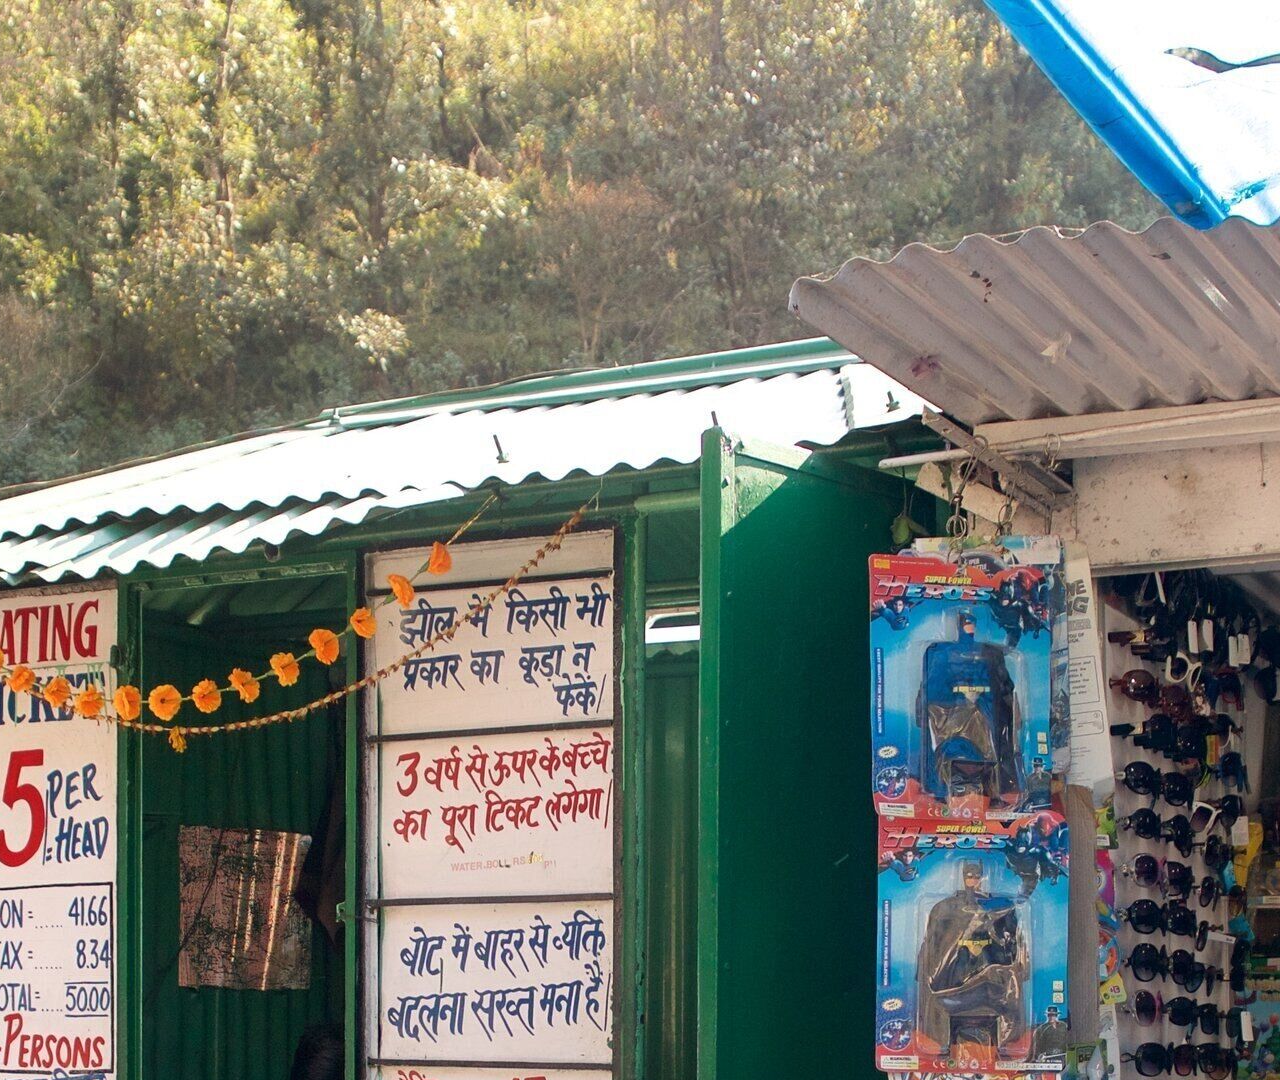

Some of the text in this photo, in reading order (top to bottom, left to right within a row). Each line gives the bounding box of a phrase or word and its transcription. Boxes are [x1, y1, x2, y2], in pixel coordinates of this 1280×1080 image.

[874, 574, 999, 600] HEROES
[924, 575, 946, 584] SUPER
[398, 598, 457, 649] झील
[505, 586, 570, 637] किसी
[575, 582, 611, 628] भी
[402, 653, 466, 691] प्रकार
[470, 649, 505, 685] का
[572, 642, 596, 674] न
[46, 763, 104, 818] PER
[396, 751, 421, 797] 3
[424, 744, 462, 793] वर्ष
[466, 744, 489, 793] से
[488, 748, 542, 789] ऊपर
[539, 737, 561, 779] के
[54, 816, 109, 864] HEAD
[393, 809, 431, 843] का
[441, 804, 478, 853] पूरा
[485, 789, 542, 834] टिकट
[883, 826, 1012, 849] HEROES
[936, 825, 960, 833] SUPER
[68, 895, 108, 927] 41.66
[76, 938, 111, 970] 8.34
[400, 926, 446, 976] बोट
[451, 923, 472, 972] में
[474, 927, 532, 978] बाहर
[529, 914, 551, 969] से
[65, 985, 110, 1012] 50.00
[387, 989, 468, 1043] बदलना
[539, 979, 584, 1027] मना
